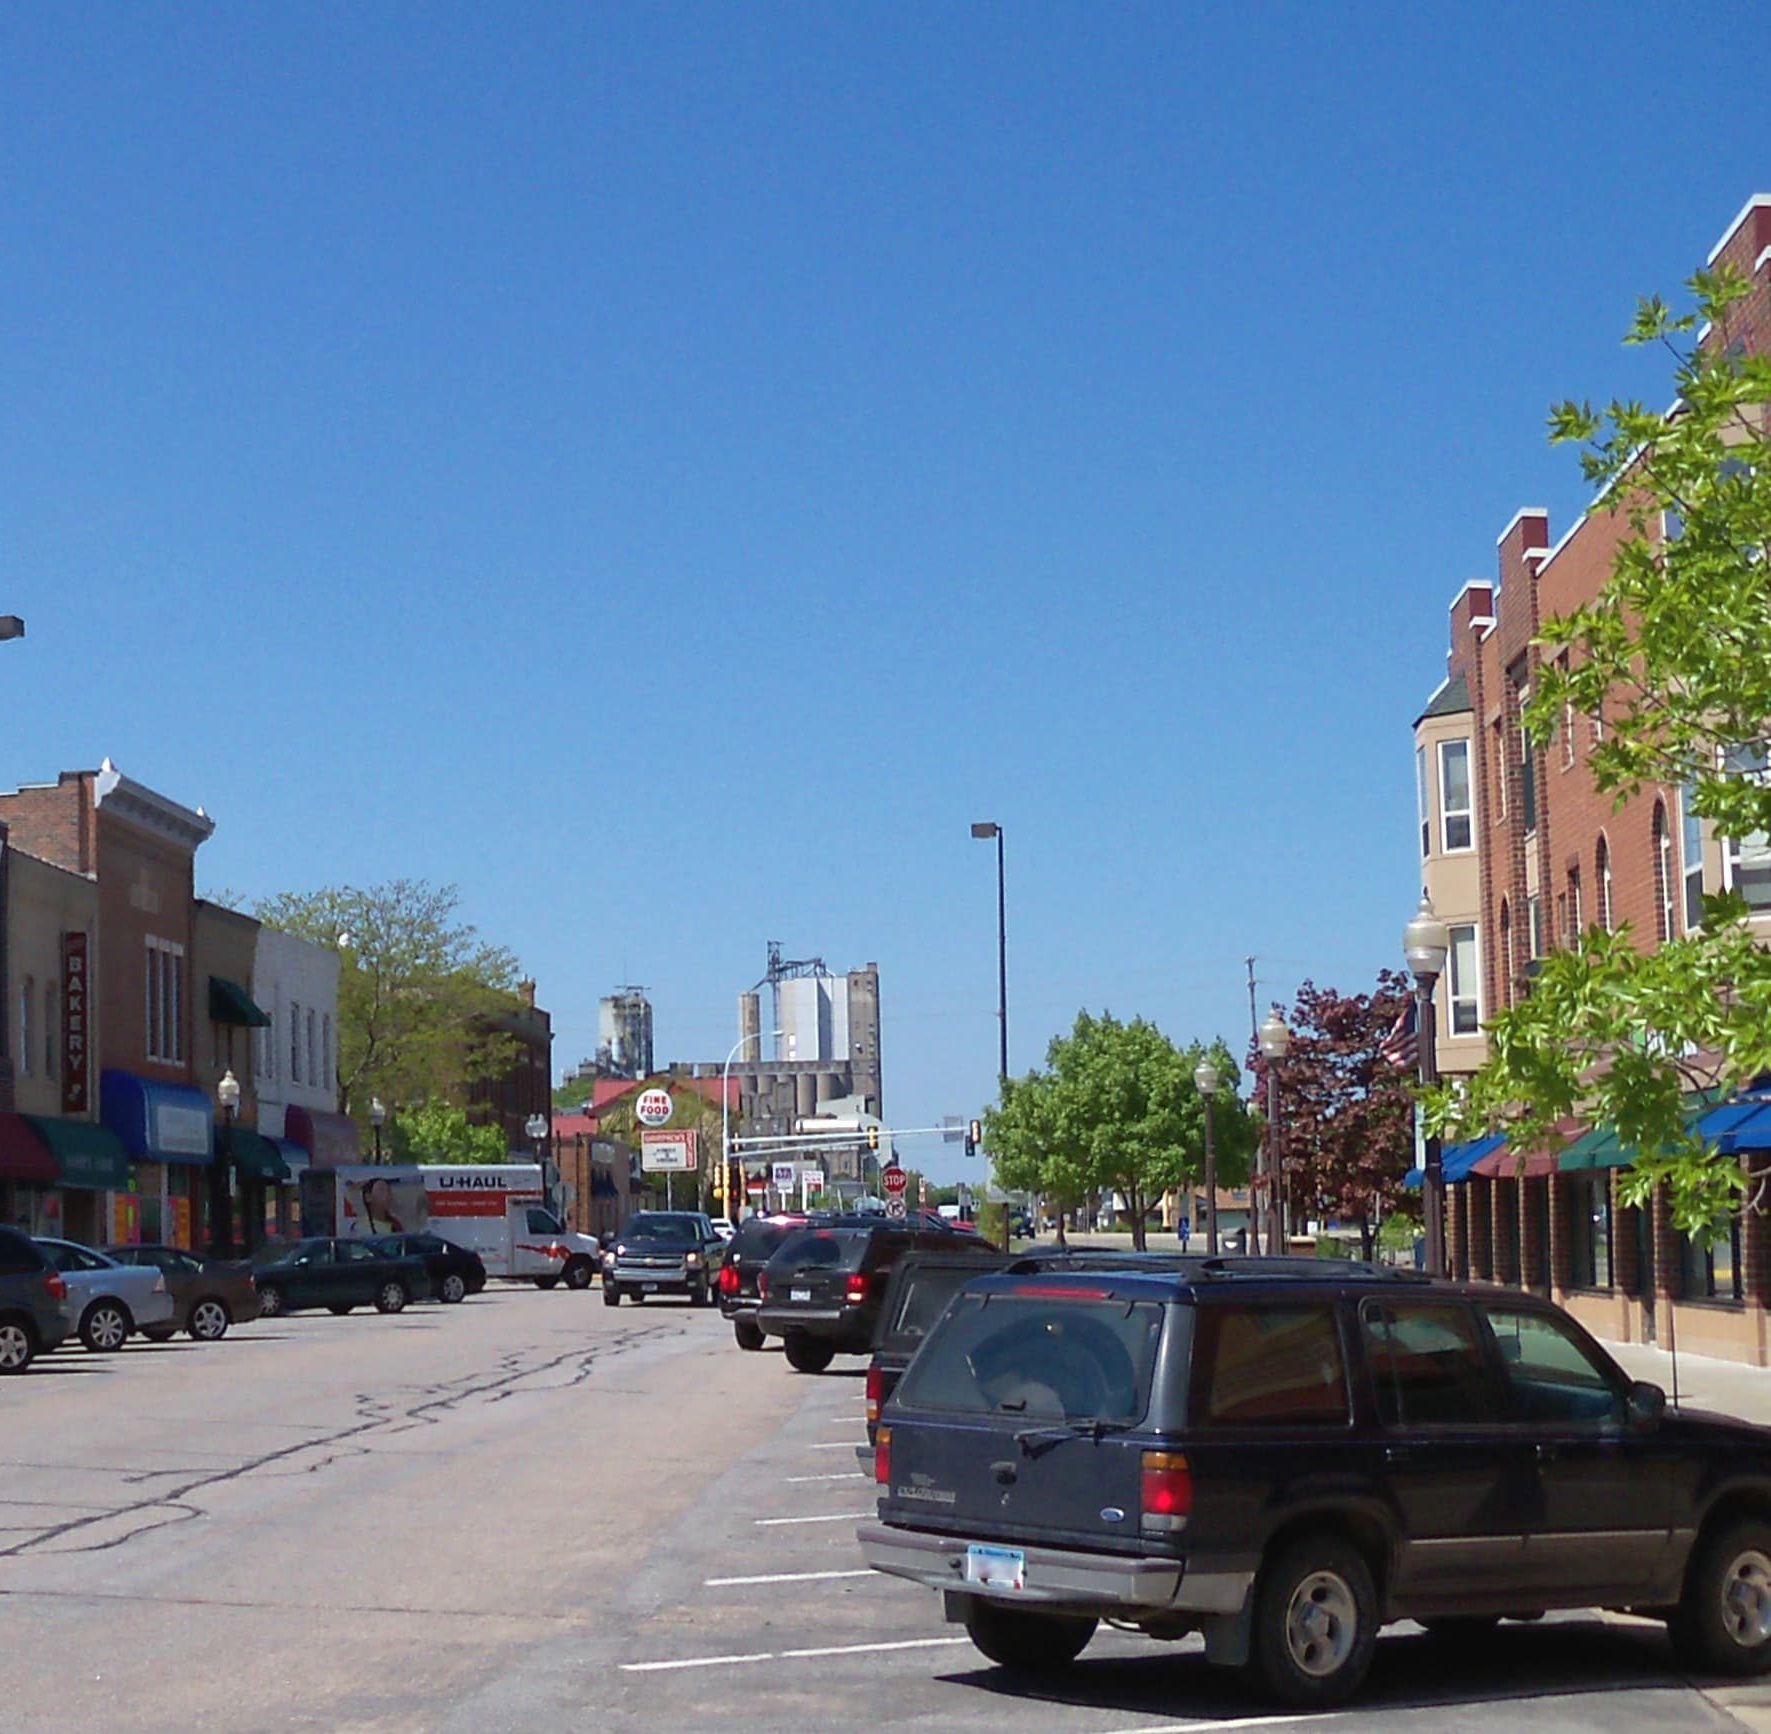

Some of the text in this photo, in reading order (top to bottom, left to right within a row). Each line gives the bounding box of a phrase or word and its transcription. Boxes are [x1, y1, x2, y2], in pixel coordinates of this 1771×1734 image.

[68, 956, 84, 1071] BAKERY
[643, 1095, 667, 1104] FINE
[640, 1105, 669, 1115] FOOD
[439, 1175, 507, 1188] U-HAUL
[883, 1175, 906, 1186] STOP
